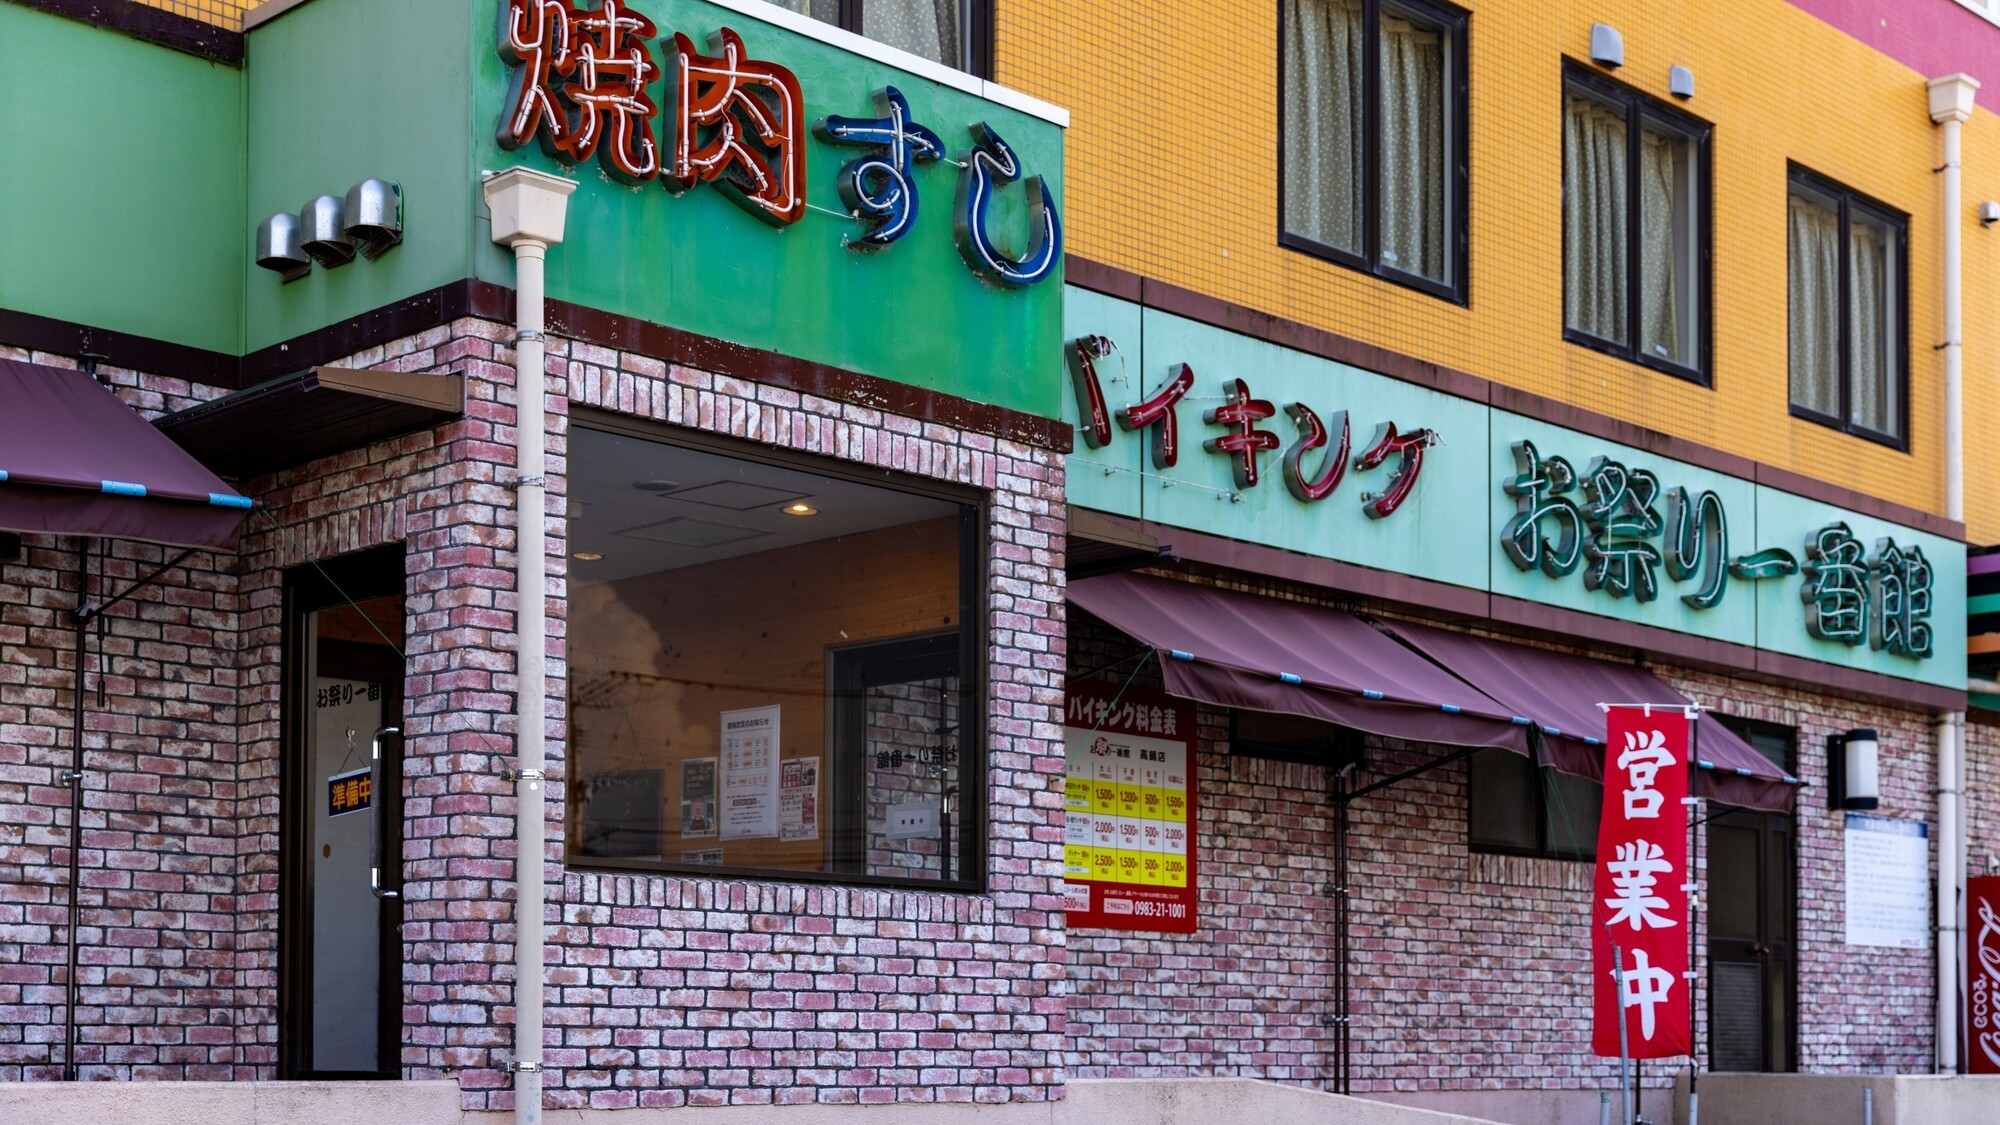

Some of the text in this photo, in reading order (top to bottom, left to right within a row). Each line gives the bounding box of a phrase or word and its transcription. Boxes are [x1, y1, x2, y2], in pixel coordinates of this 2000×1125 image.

[497, 0, 1062, 288] 焼肉 すし
[1501, 439, 1933, 659] お祭り一番館
[316, 681, 384, 708] お祭り一番
[728, 718, 770, 730] 価格改定のお知らせ
[1068, 694, 1177, 736] バイキング料金表
[1140, 749, 1166, 763] 高鍋店
[332, 776, 372, 810] 準備中
[1604, 729, 1679, 1041] 営業中
[1134, 900, 1186, 918] 0983-21-1001
